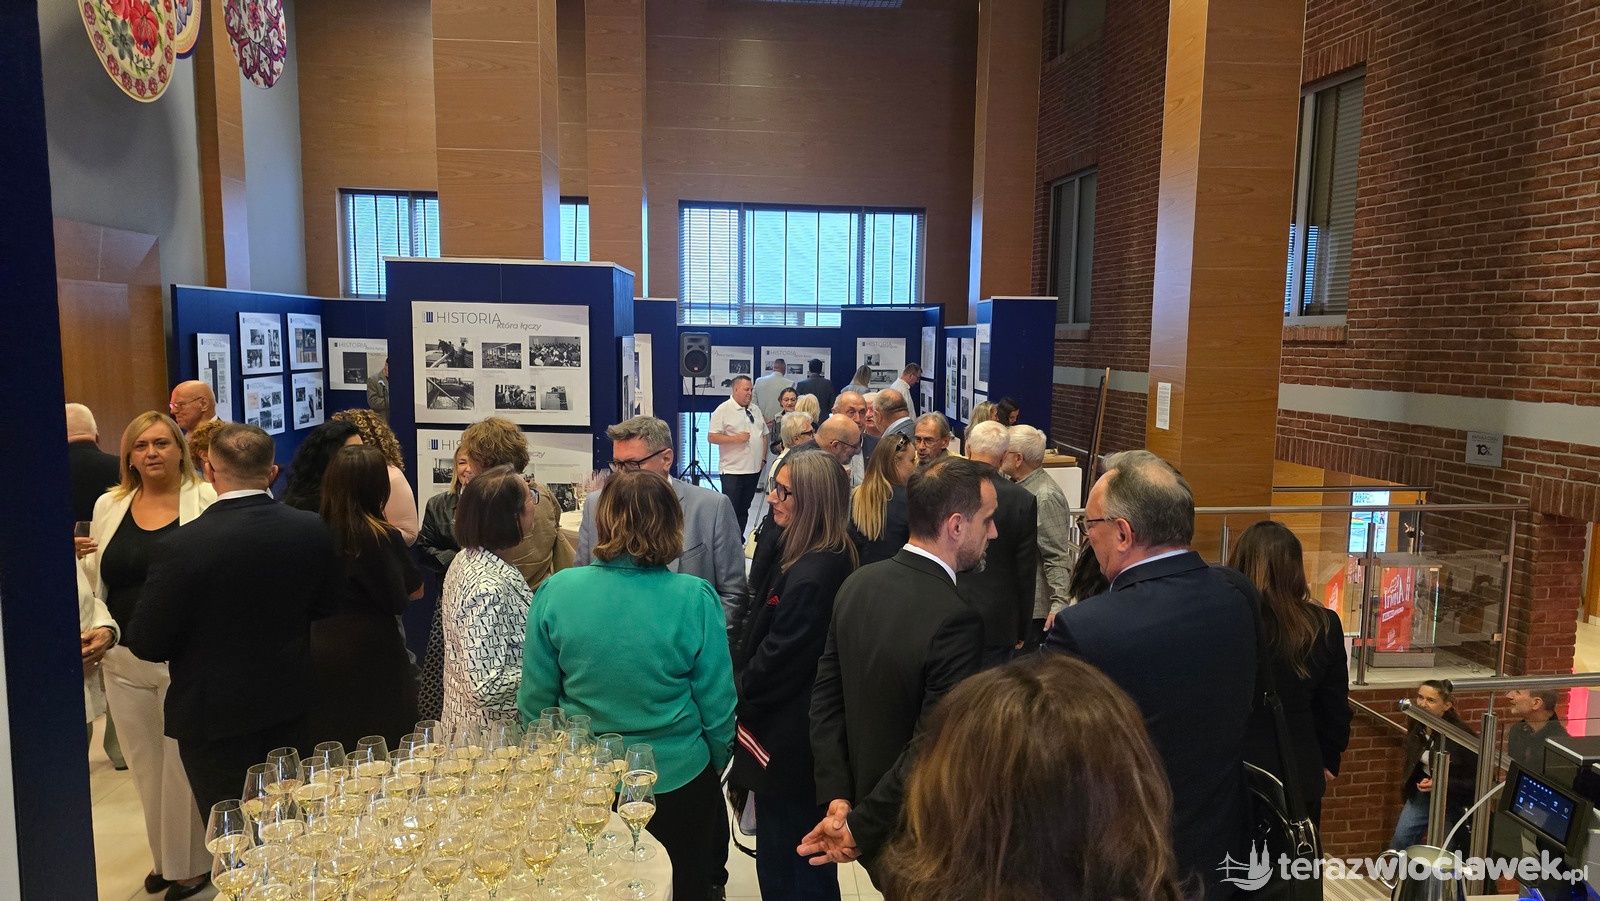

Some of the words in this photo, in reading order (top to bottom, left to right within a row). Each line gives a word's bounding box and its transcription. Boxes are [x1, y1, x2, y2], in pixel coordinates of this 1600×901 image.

[436, 311, 502, 325] HISTORIA
[496, 320, 518, 329] która
[520, 321, 542, 331] łączy
